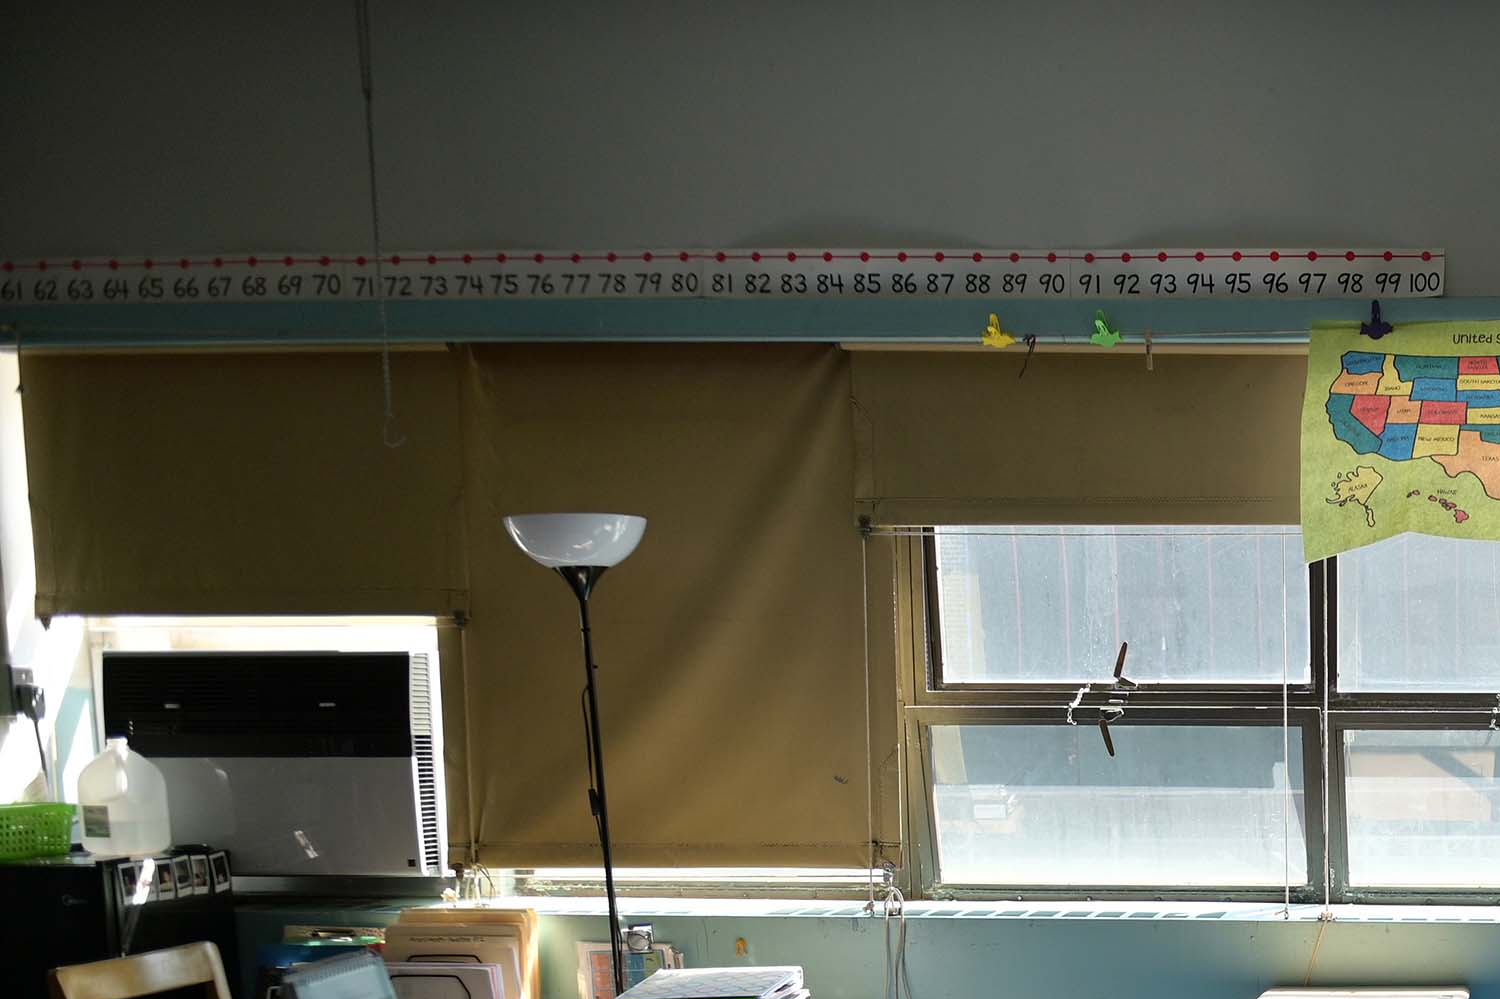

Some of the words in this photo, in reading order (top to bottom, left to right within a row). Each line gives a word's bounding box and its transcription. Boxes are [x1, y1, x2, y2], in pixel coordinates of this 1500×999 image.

[33, 278, 59, 301] 62
[67, 278, 95, 301] 63
[101, 277, 130, 300] 64
[138, 277, 163, 300] 65
[173, 276, 199, 299] 66
[207, 275, 232, 298] 67
[242, 275, 267, 298] 68
[277, 274, 303, 297] 69
[312, 274, 341, 297] 70
[352, 274, 374, 297] 71
[384, 274, 412, 297] 72
[419, 274, 448, 296] 73
[454, 274, 484, 296] 74
[490, 274, 519, 296] 75
[527, 274, 554, 295] 76
[561, 274, 591, 295] 77
[598, 274, 626, 295] 78
[635, 274, 662, 294] 79
[671, 274, 699, 294] 80
[711, 273, 734, 295] 81
[745, 273, 772, 295] 82
[780, 273, 809, 295] 83
[817, 273, 844, 295] 84
[853, 273, 882, 295] 85
[891, 273, 918, 295] 86
[926, 273, 954, 295] 87
[965, 273, 991, 295] 88
[1002, 273, 1027, 295] 89
[1039, 273, 1065, 295] 90
[1079, 273, 1100, 295] 91
[1113, 273, 1140, 295] 92
[1150, 273, 1177, 295] 93
[1186, 273, 1214, 295] 94
[1223, 273, 1251, 295] 95
[1260, 273, 1290, 295] 96
[1298, 273, 1326, 295] 97
[1337, 273, 1364, 295] 98
[1375, 273, 1402, 295] 99
[1409, 273, 1440, 295] 100
[1453, 334, 1493, 345] United
